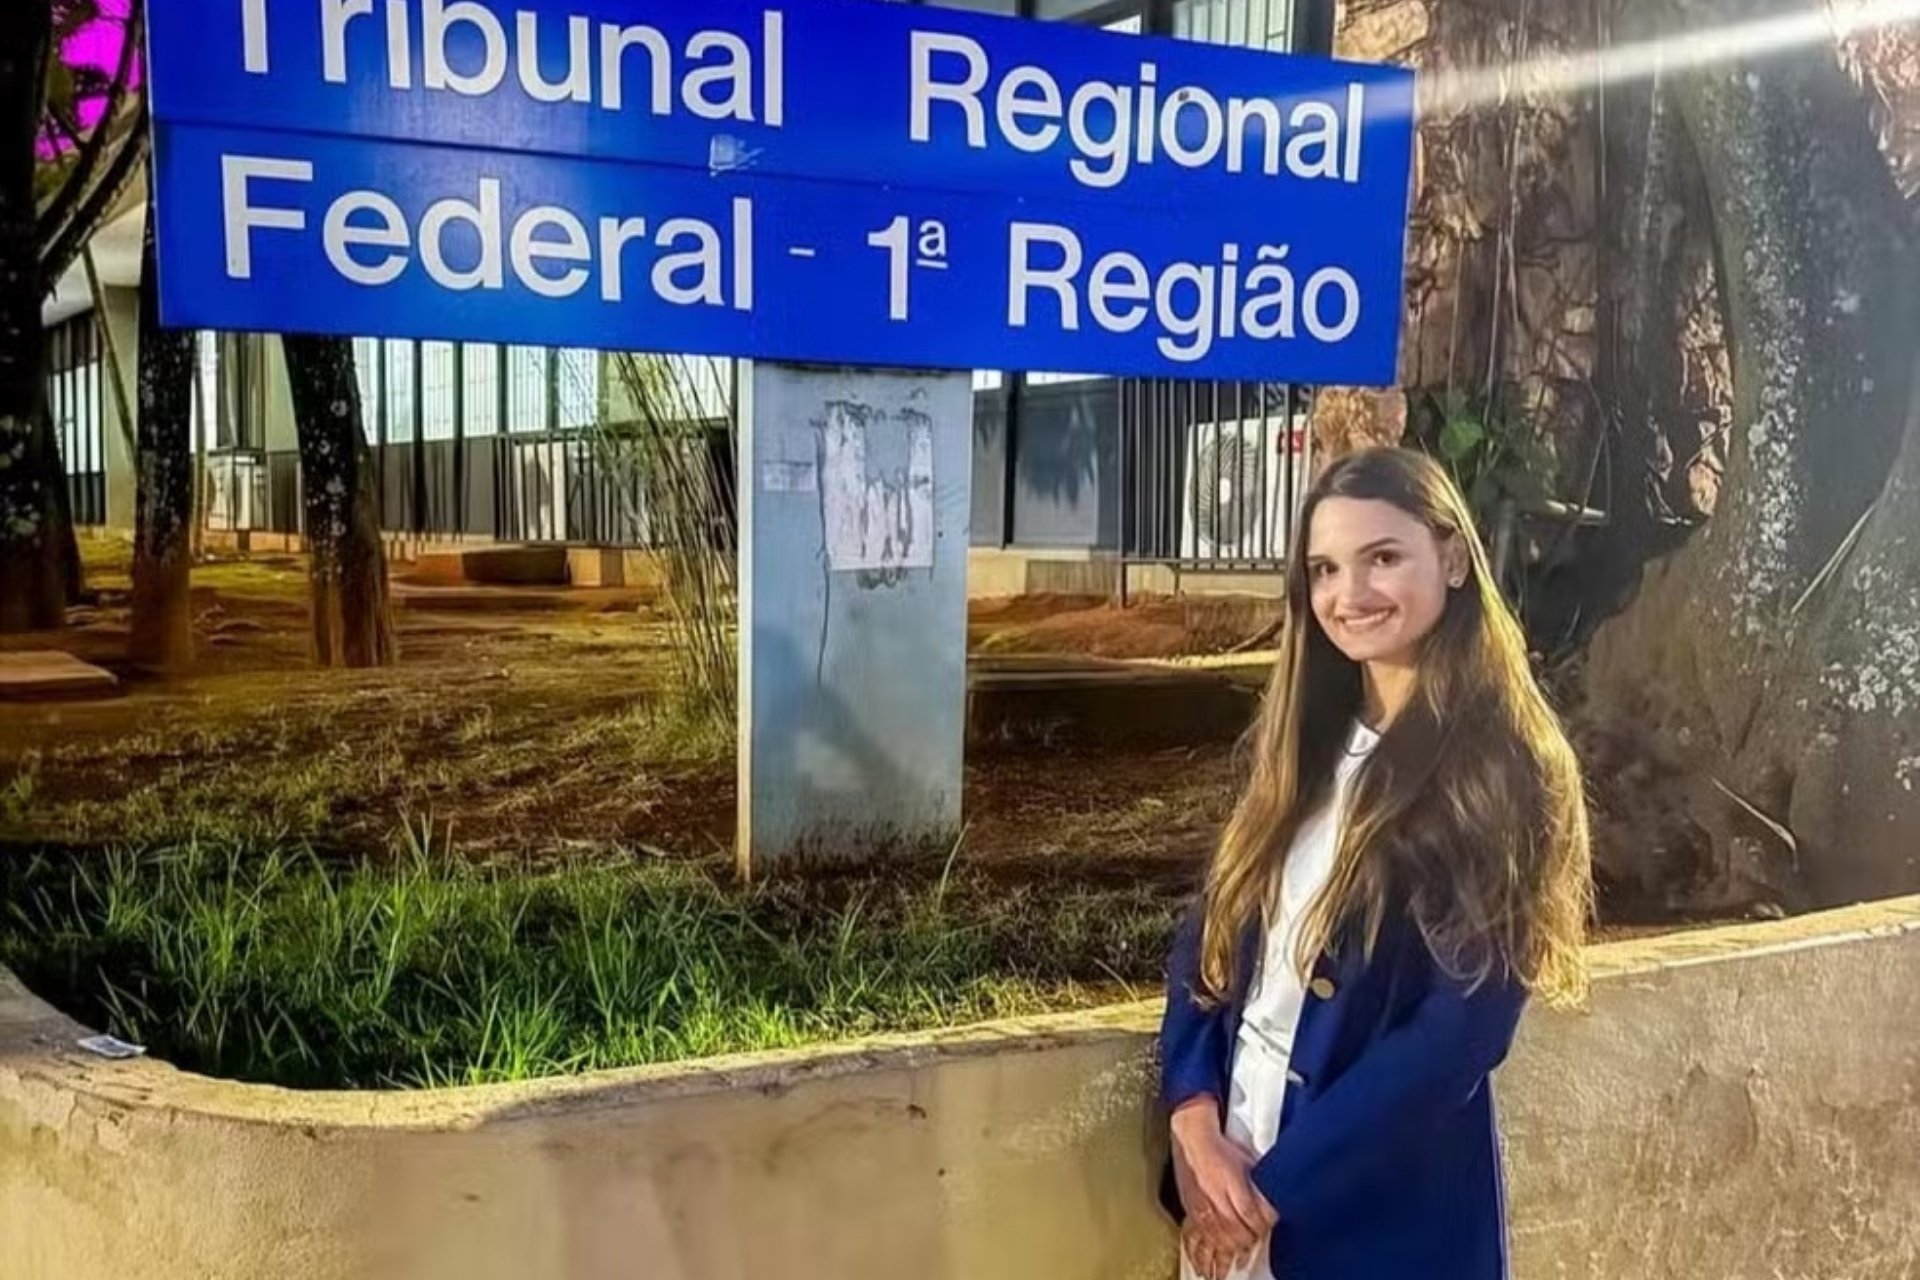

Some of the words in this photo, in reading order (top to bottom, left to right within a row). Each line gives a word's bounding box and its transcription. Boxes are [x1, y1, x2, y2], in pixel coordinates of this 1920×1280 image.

[909, 31, 1364, 188] Regional
[221, 154, 753, 311] Federal
[789, 247, 815, 257] -
[867, 215, 948, 321] 1ª
[1007, 222, 1360, 362] Região
